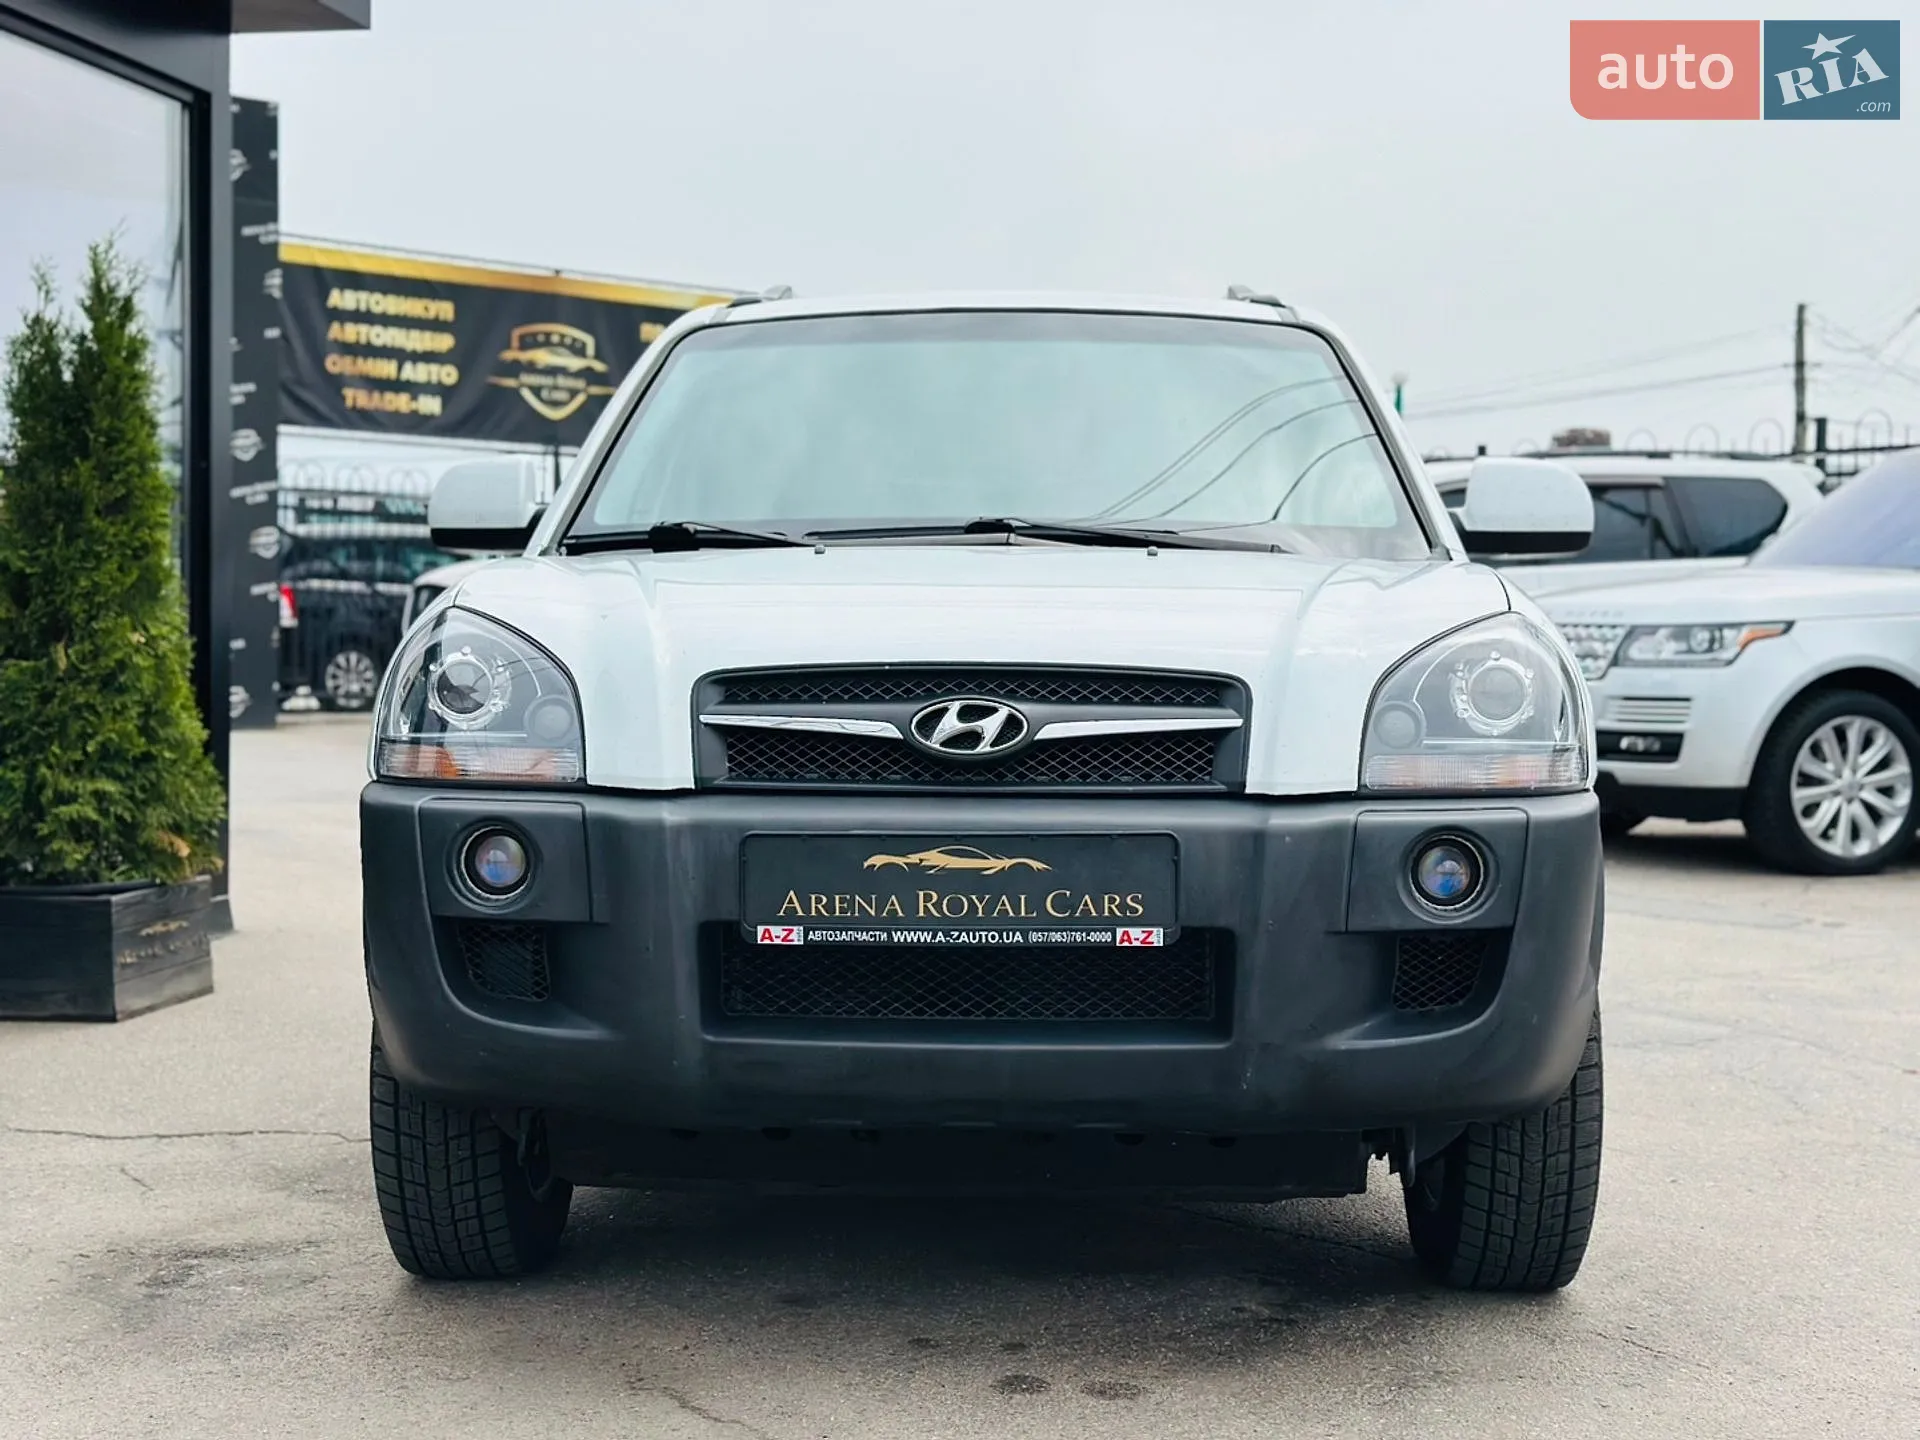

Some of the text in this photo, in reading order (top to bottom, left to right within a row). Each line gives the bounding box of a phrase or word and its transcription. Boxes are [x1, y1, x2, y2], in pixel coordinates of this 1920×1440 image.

[326, 287, 455, 322] АВТОВИКУП
[400, 360, 459, 386] АВТО
[341, 386, 443, 417] TRADE-IN
[776, 889, 1144, 918] ARENA ROYAL CARS
[759, 927, 796, 943] A-Z
[807, 930, 888, 943] АВТОЗАПЧАСТИ
[891, 930, 1024, 944] WWW.A-ZAUTO.UA
[1118, 929, 1155, 945] A-Z
